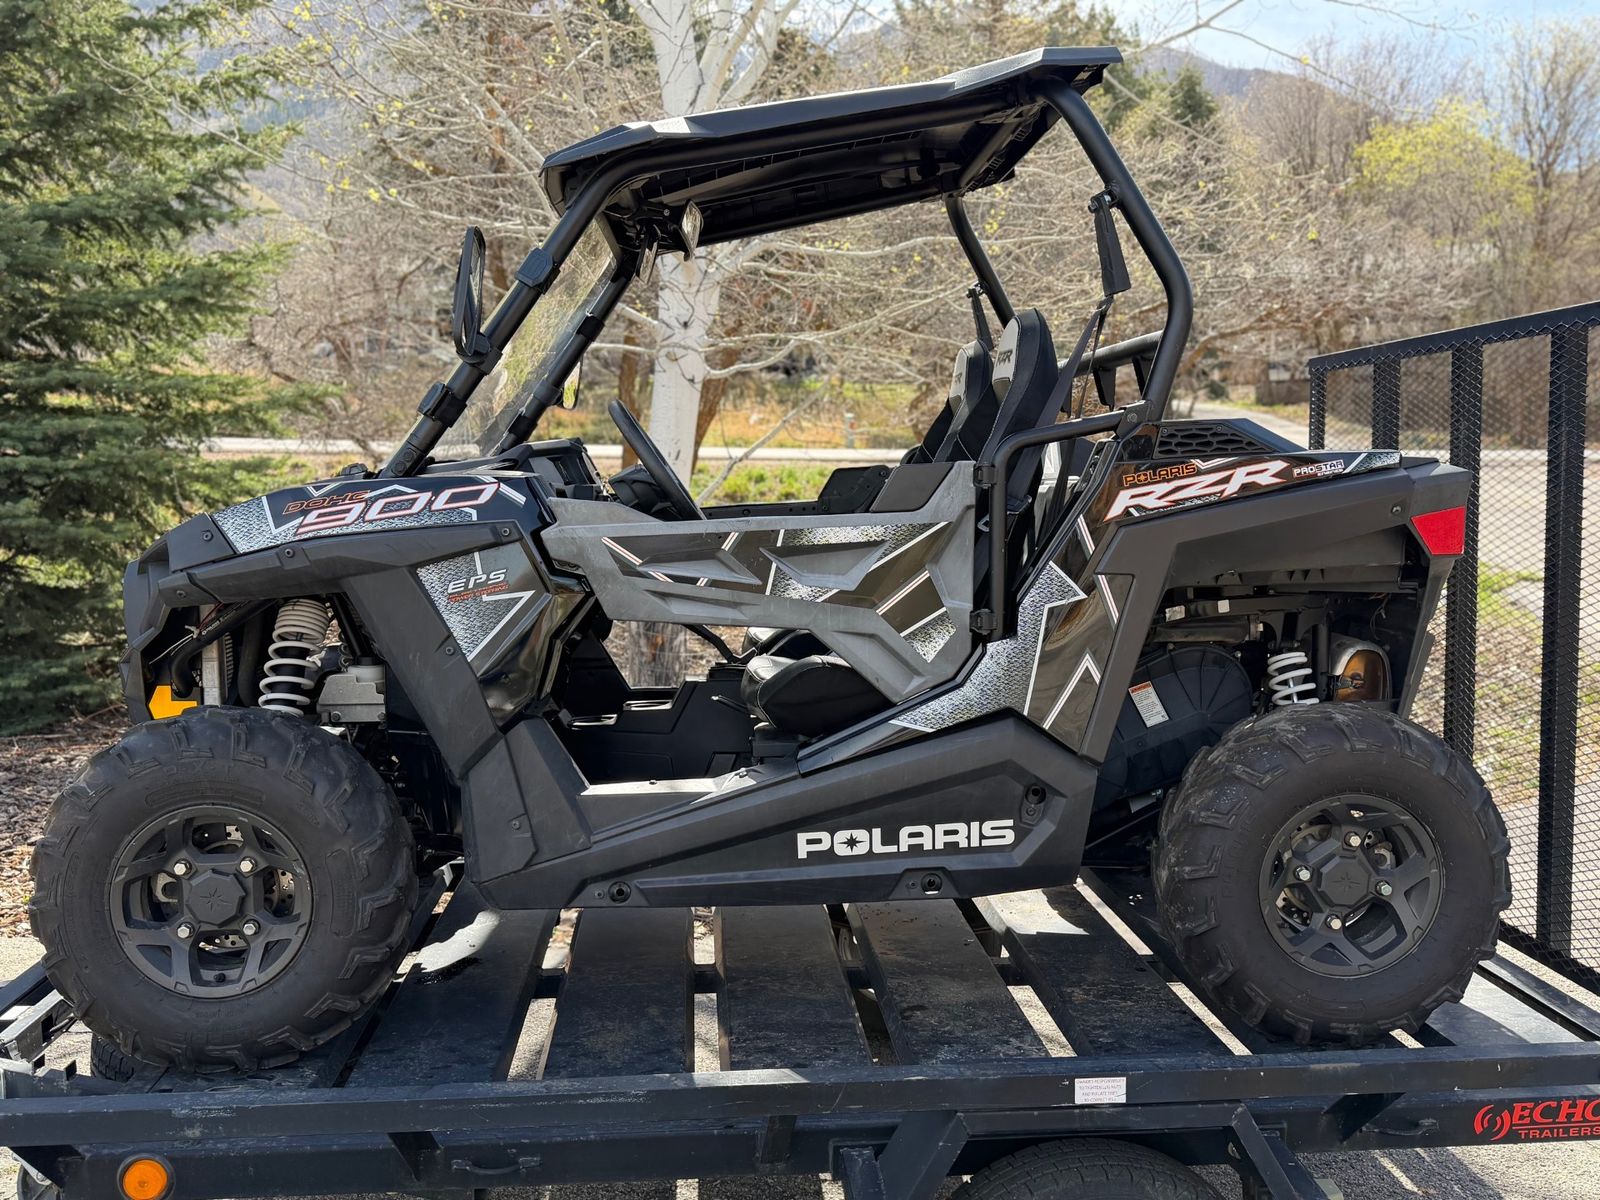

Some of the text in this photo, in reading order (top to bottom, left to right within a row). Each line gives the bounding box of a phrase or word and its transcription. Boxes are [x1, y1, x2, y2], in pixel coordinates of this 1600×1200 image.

[1123, 464, 1197, 487] POLARIS
[1294, 460, 1344, 477] PROSTAR
[283, 490, 370, 515] DOHC
[1103, 459, 1291, 523] RZR
[295, 482, 499, 535] 900
[448, 569, 507, 593] EPS
[797, 819, 1015, 859] POLARIS
[1518, 1127, 1600, 1139] TRAILERS
